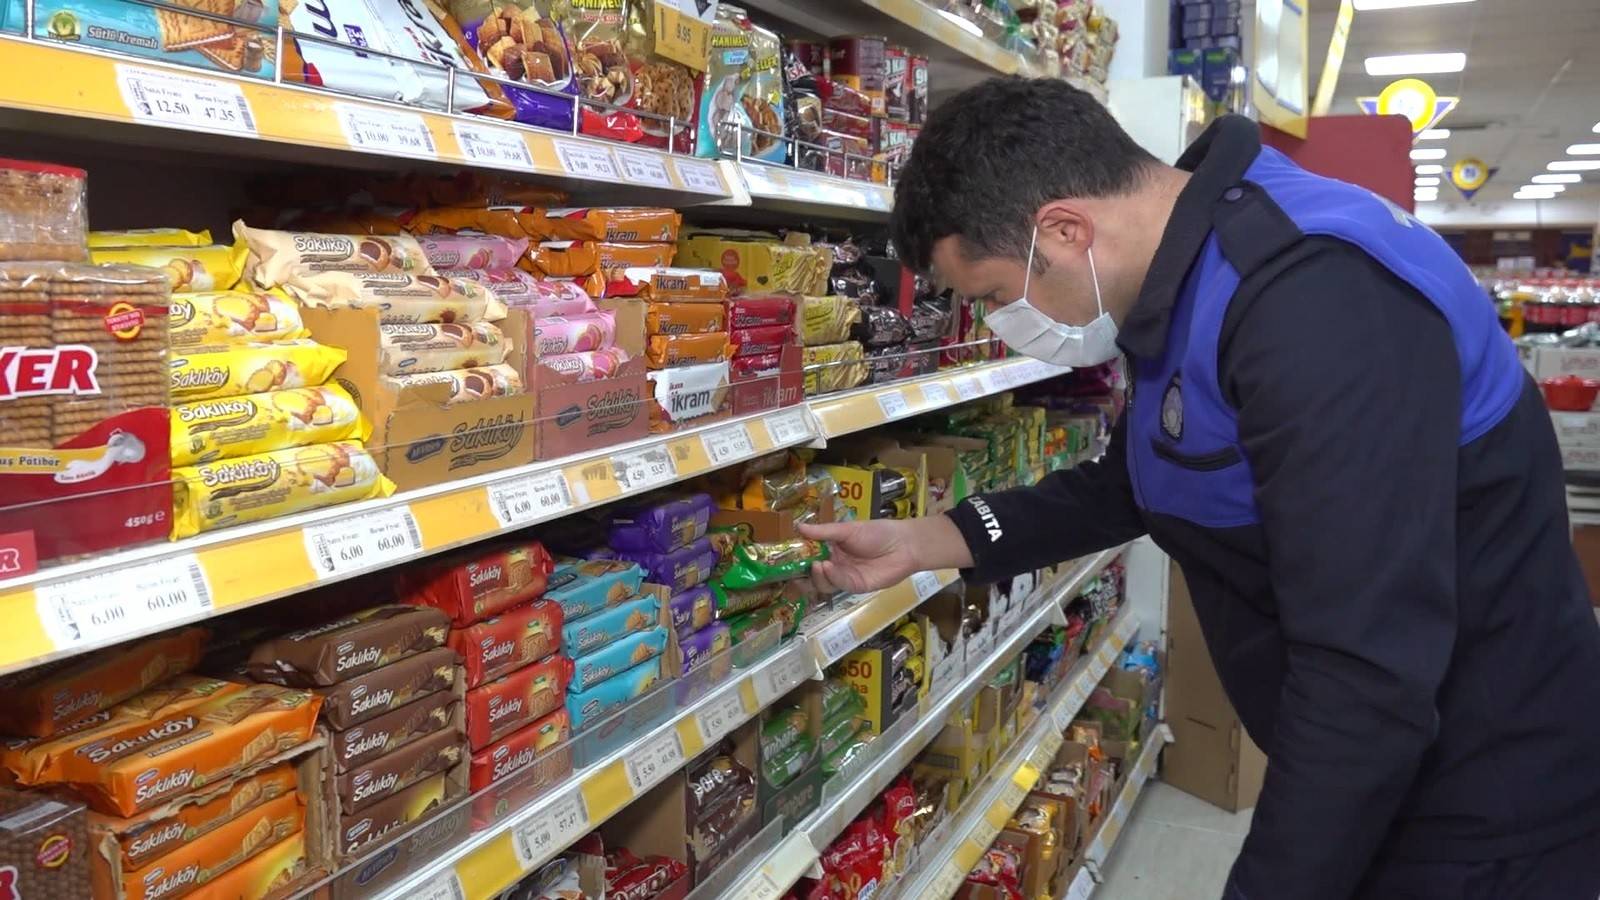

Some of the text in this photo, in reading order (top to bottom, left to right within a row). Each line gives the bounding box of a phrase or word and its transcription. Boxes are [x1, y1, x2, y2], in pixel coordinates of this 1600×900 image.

[87, 25, 159, 50] Sütlü Kremalı
[294, 235, 353, 254] Saklıköy
[606, 227, 639, 241] ikram
[656, 275, 688, 290] ikram
[659, 320, 688, 334] ikram
[171, 366, 230, 389] Saklıköy
[179, 399, 256, 422] Saklıköy
[587, 387, 641, 419] Saklıköy
[671, 390, 711, 413] ikram
[451, 412, 525, 453] Saklıköy
[19, 456, 61, 468] Pötibör
[199, 457, 281, 487] Saklıköy
[514, 493, 561, 514] 6,00 60,00
[340, 533, 406, 561] 6,00 60,00
[469, 565, 501, 588] Saklıköy
[91, 588, 189, 627] 6,00 60,00
[337, 646, 381, 673] Saklıköy
[482, 639, 515, 664] Saklıköy
[351, 688, 395, 717] Saklıköy
[489, 698, 522, 723] Saklıköy
[89, 714, 196, 765] Saklıköy
[345, 730, 389, 759] Saklıköy
[492, 747, 535, 781] Saklıköy
[135, 768, 194, 804] Saklıköy
[354, 773, 398, 802] Saklıköy
[128, 822, 187, 859] Saklıköy
[145, 865, 199, 900] Saklıköy
